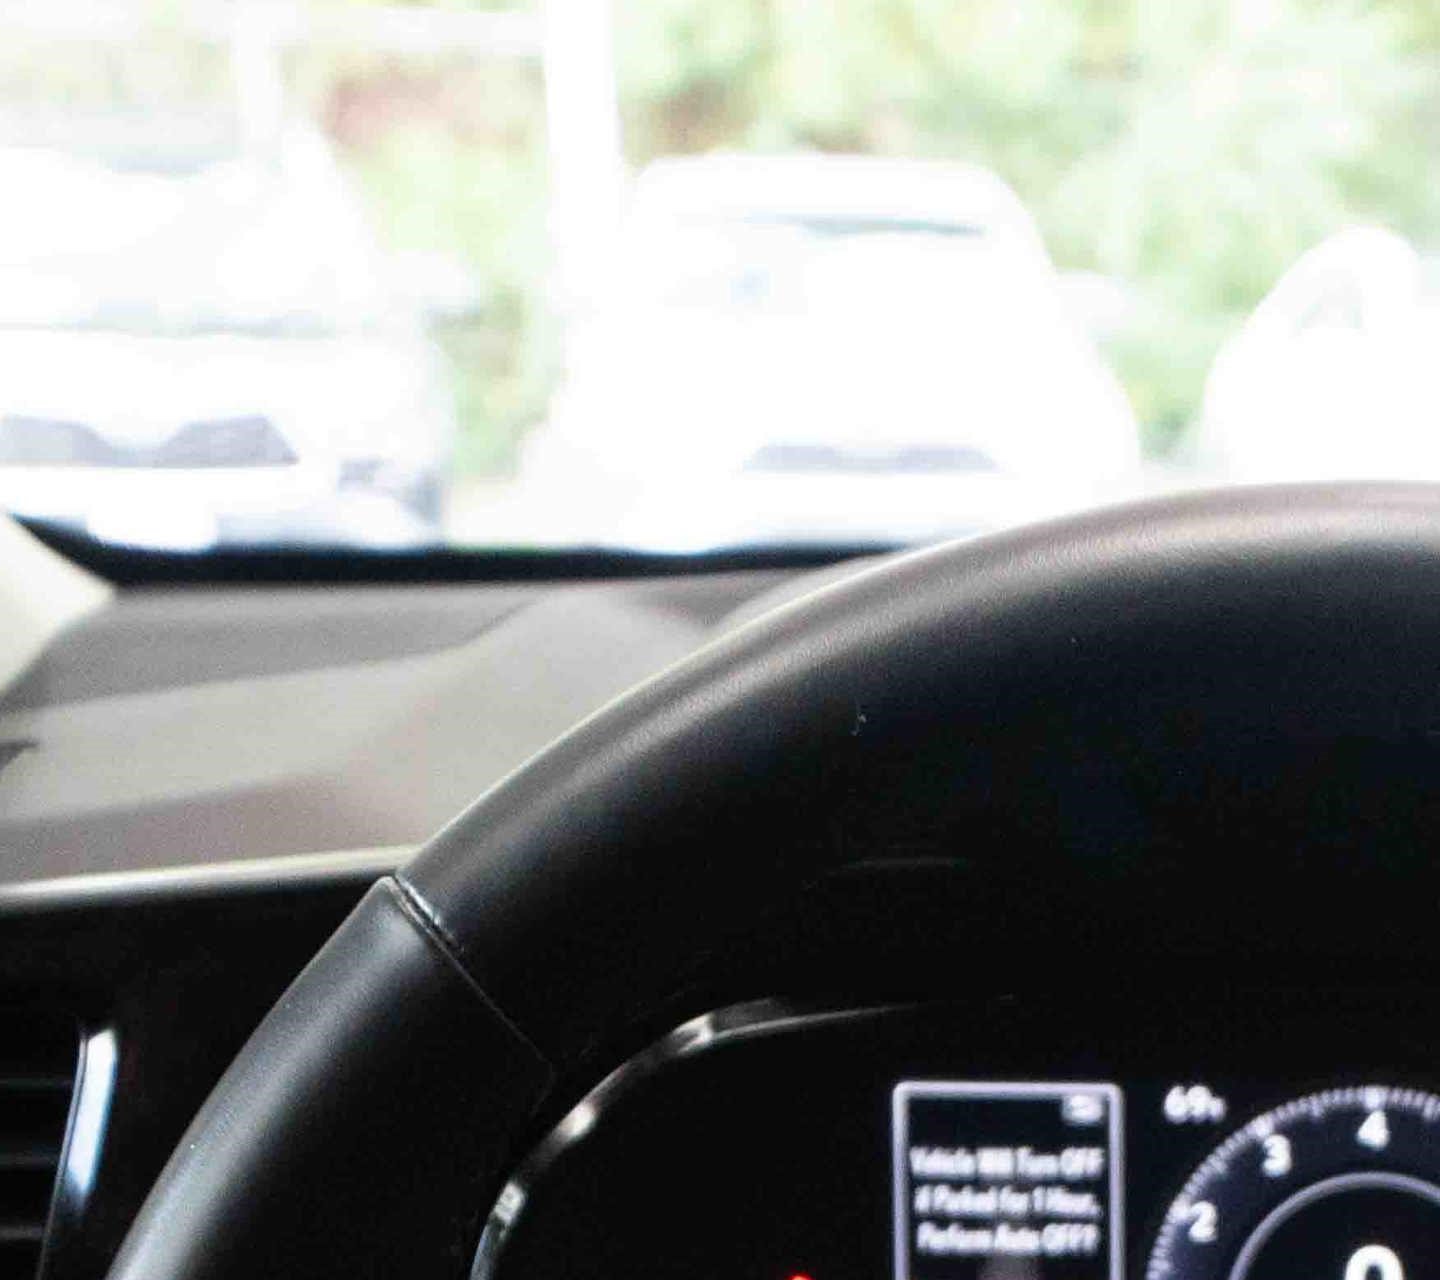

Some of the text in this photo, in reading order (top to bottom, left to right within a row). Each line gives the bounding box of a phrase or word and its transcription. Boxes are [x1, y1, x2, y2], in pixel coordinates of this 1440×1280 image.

[1357, 1110, 1389, 1150] 4
[1263, 1134, 1292, 1176] 3
[1188, 1201, 1218, 1243] 2
